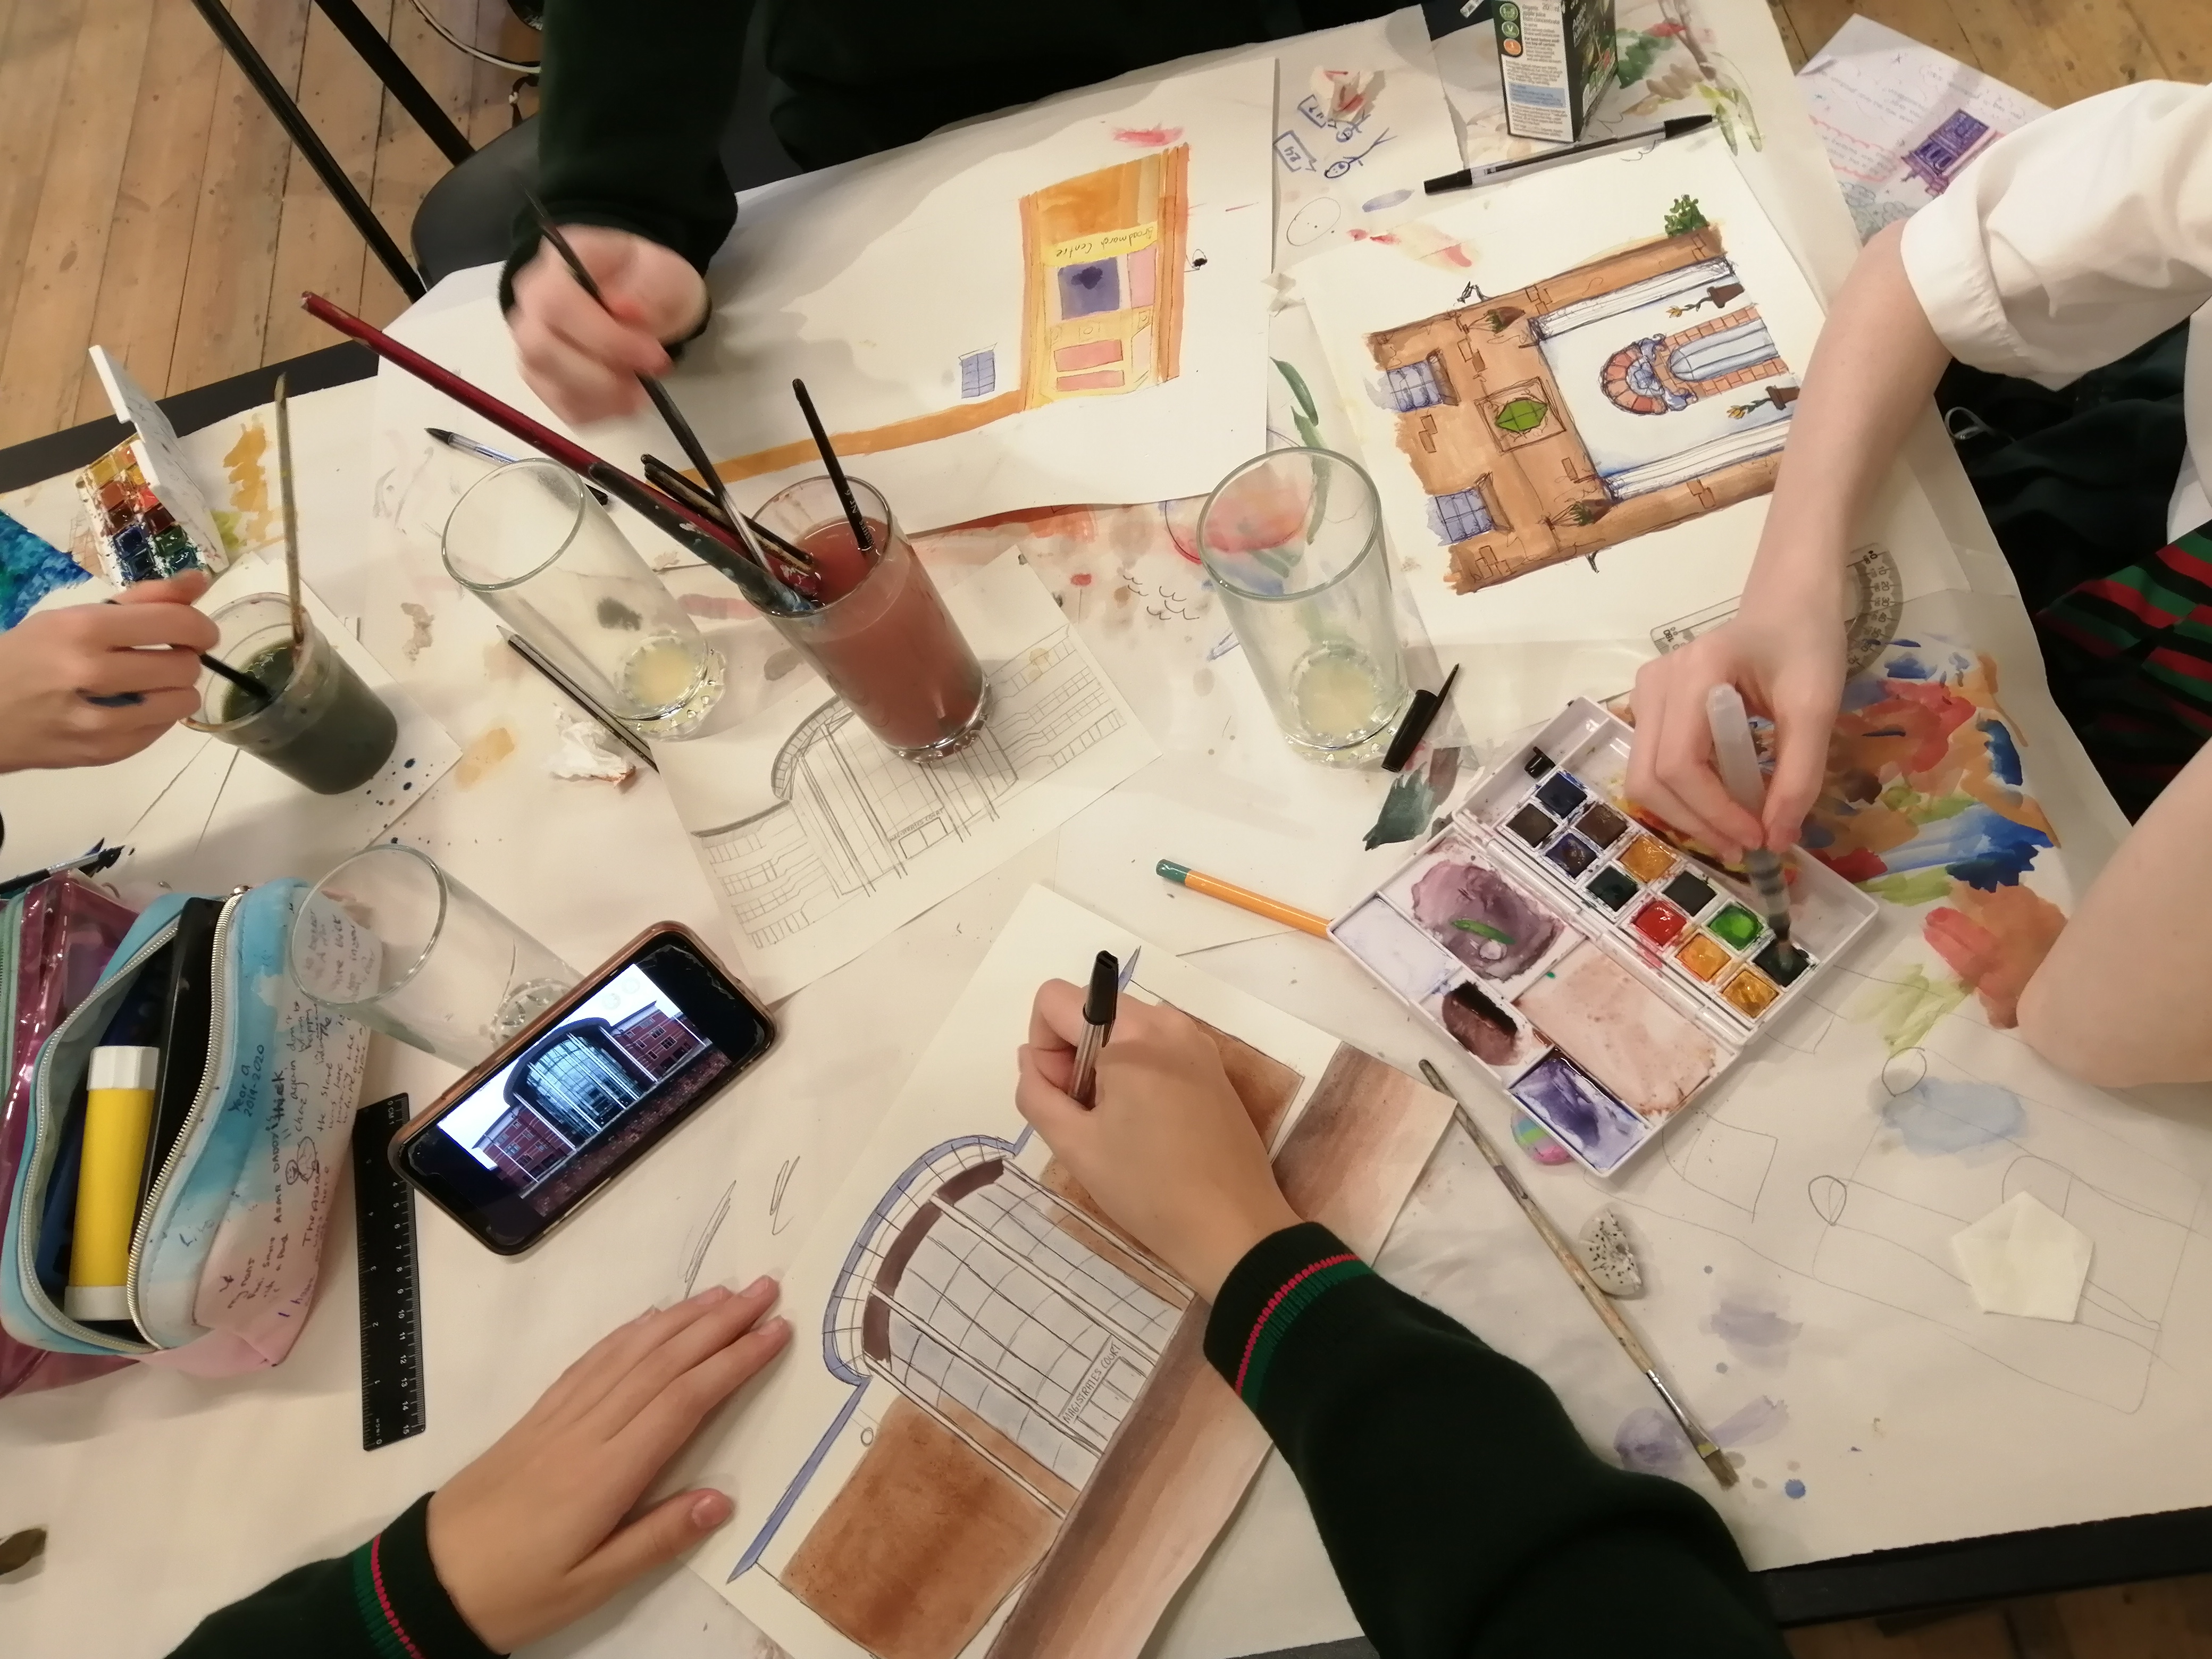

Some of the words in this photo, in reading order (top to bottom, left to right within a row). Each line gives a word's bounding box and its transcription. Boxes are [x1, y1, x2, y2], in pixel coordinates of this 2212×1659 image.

[1055, 242, 1093, 259] Centre
[1878, 565, 1887, 575] 10
[1881, 581, 1890, 591] 20
[1881, 597, 1890, 607] 30
[1878, 612, 1887, 623] 40
[889, 820, 924, 843] MAGISTRATES
[925, 809, 944, 822] COURT
[244, 1044, 264, 1118] 2019-2020
[228, 1083, 246, 1111] Year
[302, 1214, 314, 1246] The
[398, 1309, 405, 1319] 10
[399, 1331, 406, 1340] 11
[400, 1354, 407, 1365] 12
[401, 1377, 408, 1388] 13
[1062, 1367, 1102, 1425] MAGISTRATES
[1101, 1339, 1121, 1369] COURT
[401, 1401, 409, 1412] 14
[403, 1424, 410, 1435] 15
